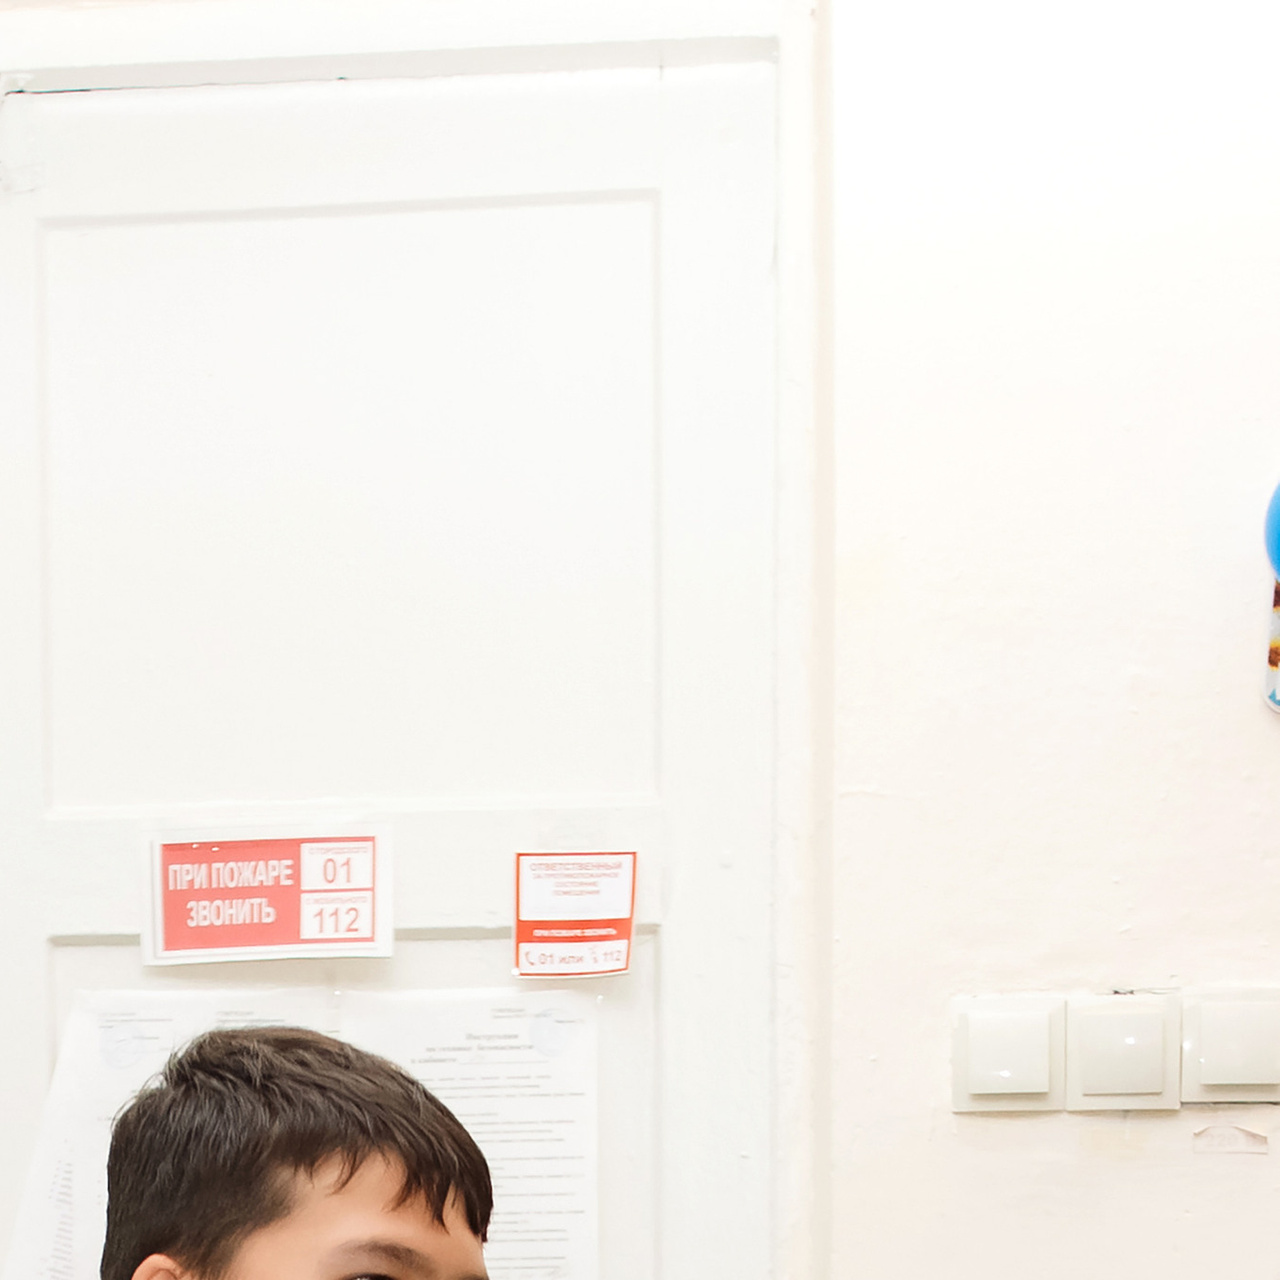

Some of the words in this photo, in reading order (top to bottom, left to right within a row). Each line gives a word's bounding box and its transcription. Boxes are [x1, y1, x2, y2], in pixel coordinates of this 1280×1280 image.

[169, 863, 209, 890] ПРИ
[211, 859, 294, 888] ПОЖАРЕ
[323, 857, 352, 884] 01
[186, 897, 276, 927] ЗВОНИТЬ
[313, 907, 360, 933] 112
